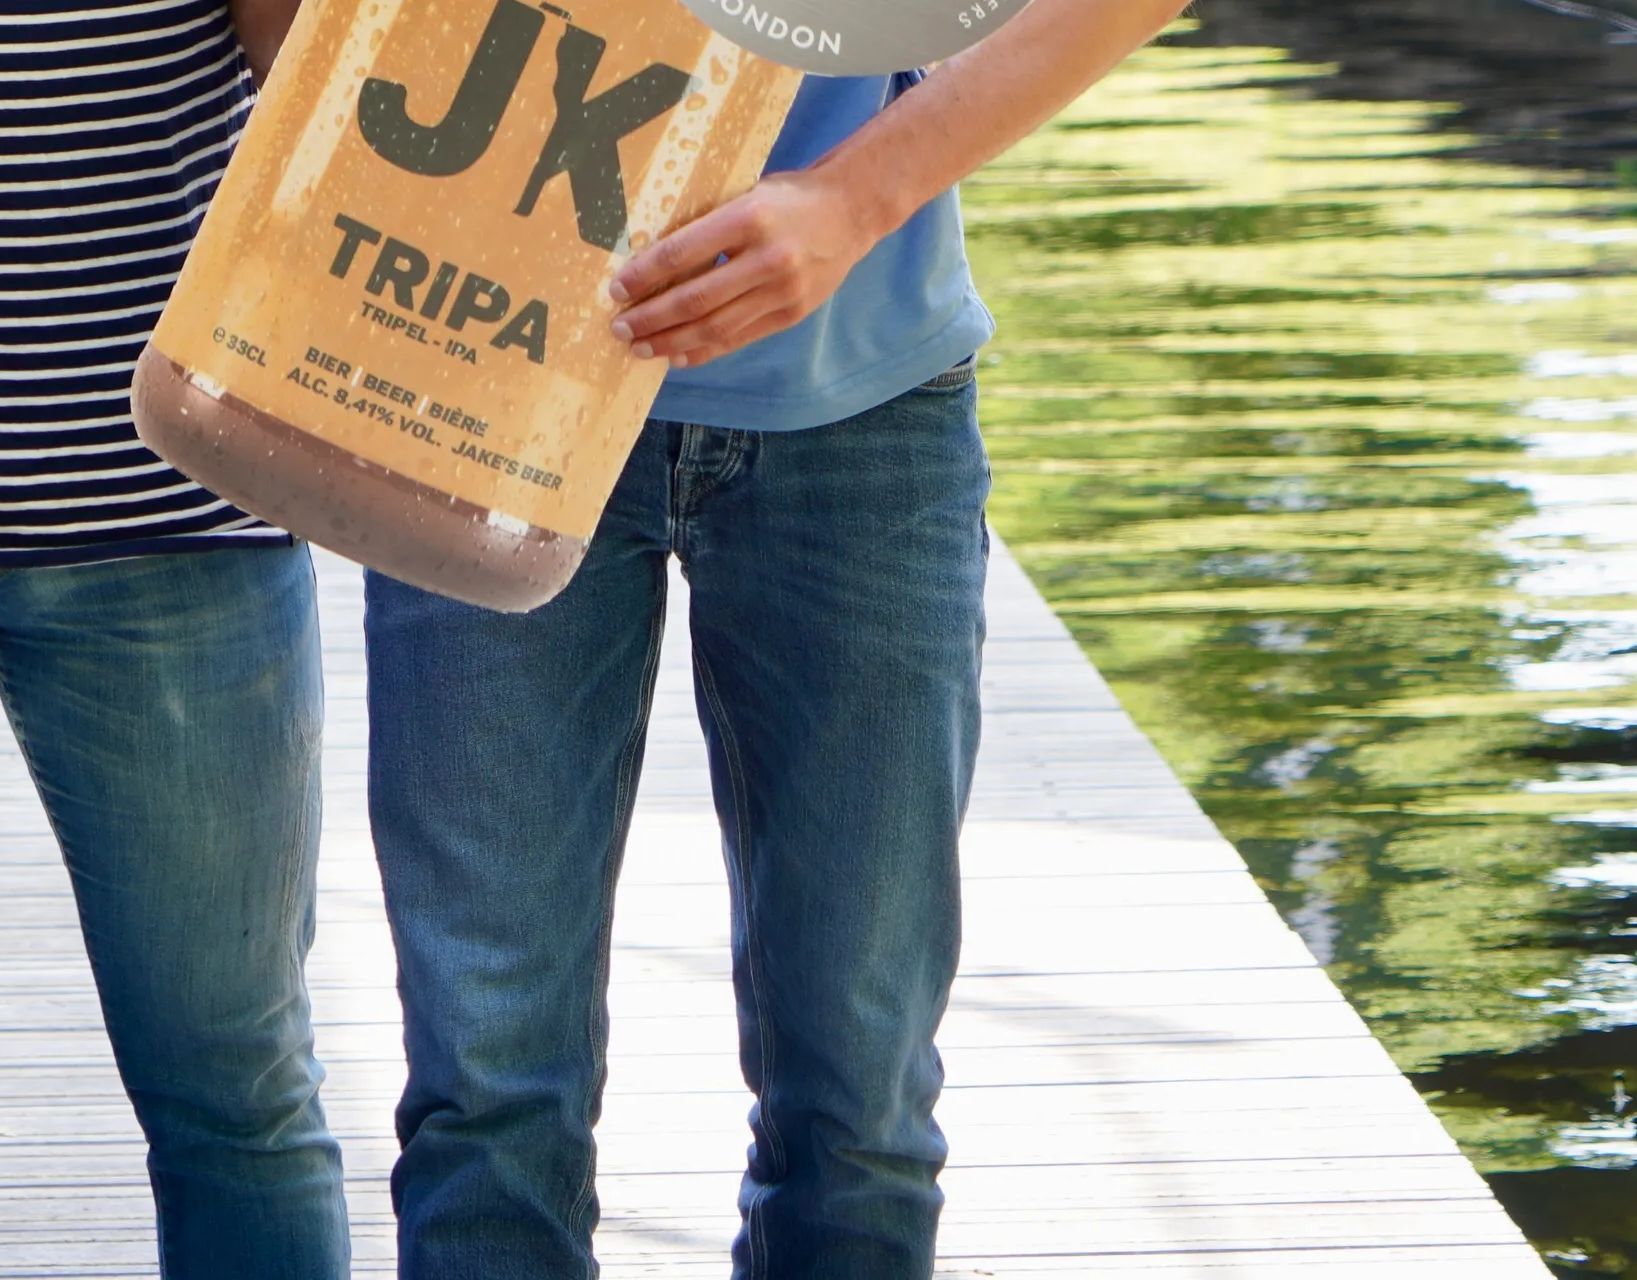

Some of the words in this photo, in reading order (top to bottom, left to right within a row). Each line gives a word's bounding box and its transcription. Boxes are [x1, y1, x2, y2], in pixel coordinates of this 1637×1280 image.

[328, 211, 549, 364] TRIPA
[361, 301, 428, 345] TRIPEL
[444, 337, 477, 365] IPA
[226, 333, 267, 367] 33CL
[304, 346, 351, 380] BIER
[363, 374, 417, 409] BEER
[428, 402, 489, 437] BIÈRE
[286, 367, 329, 398] ALC.
[333, 388, 394, 426] 8,41%
[399, 416, 441, 447] VOL.
[451, 440, 518, 476] JAKE'S
[520, 465, 563, 491] BEER
